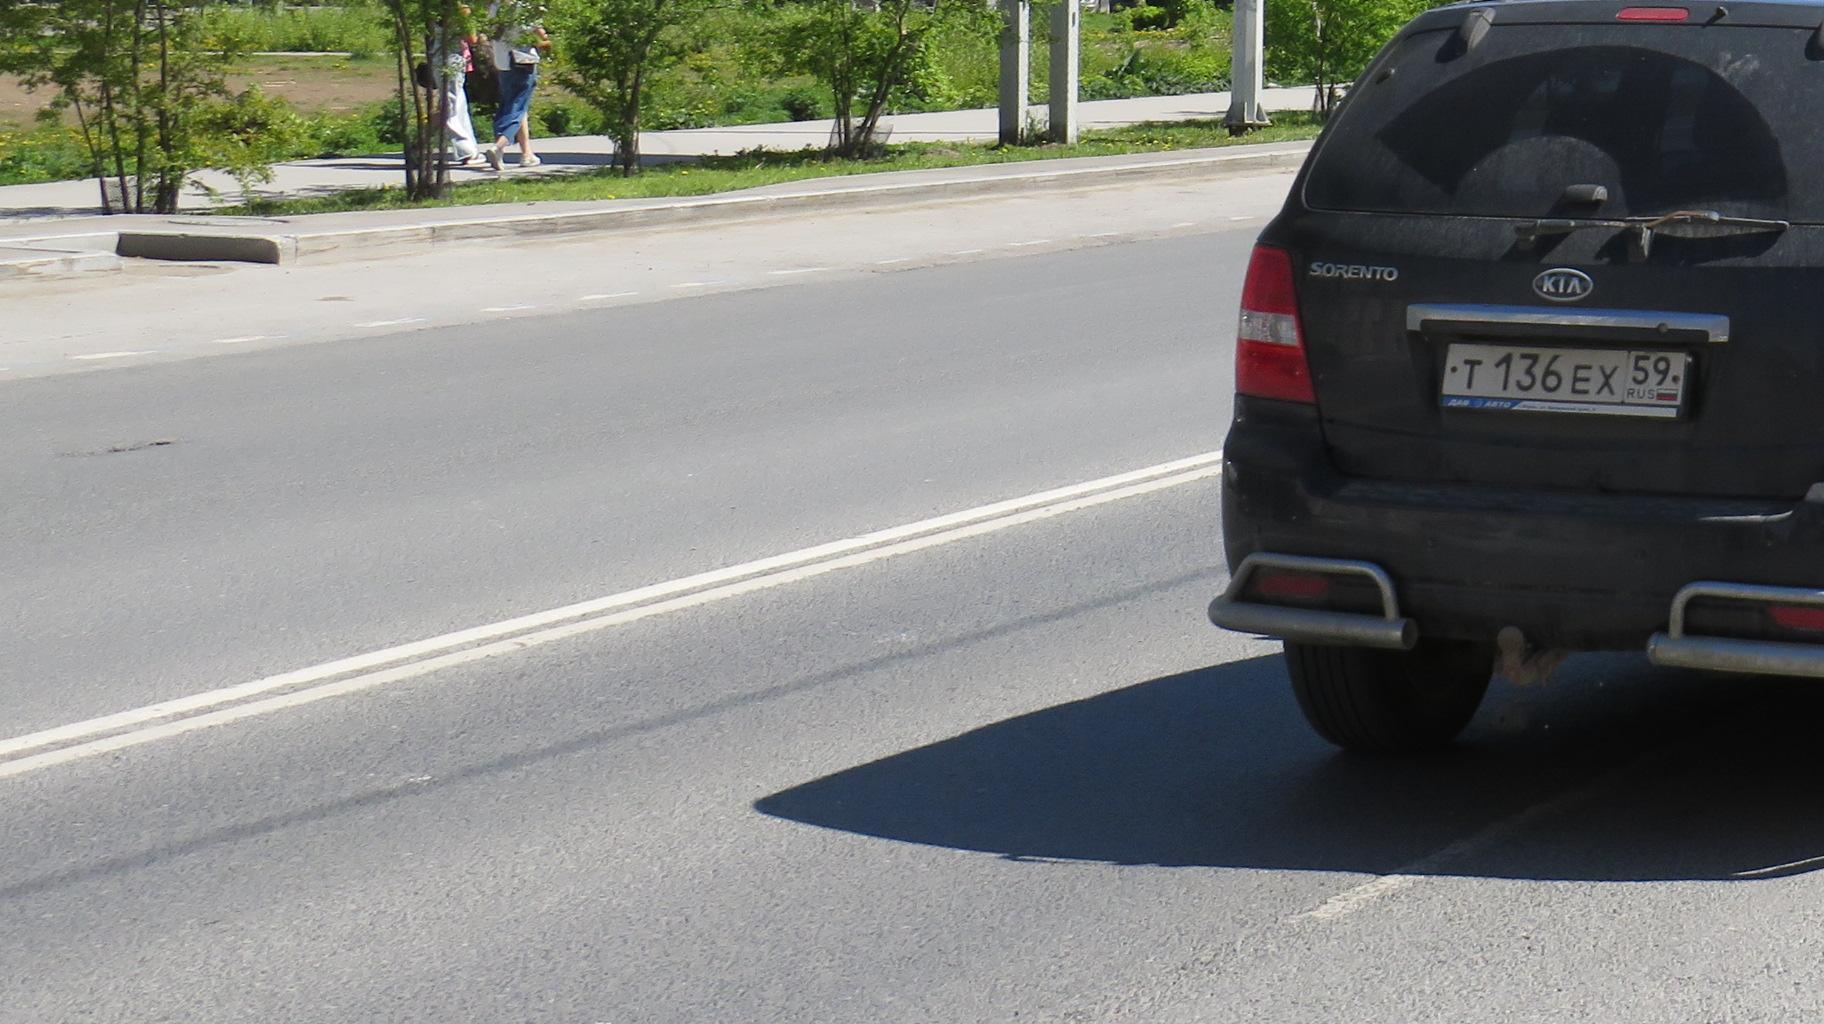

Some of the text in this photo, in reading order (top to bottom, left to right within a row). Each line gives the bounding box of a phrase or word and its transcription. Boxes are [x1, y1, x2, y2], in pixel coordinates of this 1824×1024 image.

[1309, 261, 1399, 281] SORENTO
[1541, 277, 1583, 294] KIA
[1631, 355, 1671, 387] 59
[1626, 387, 1656, 400] RUS
